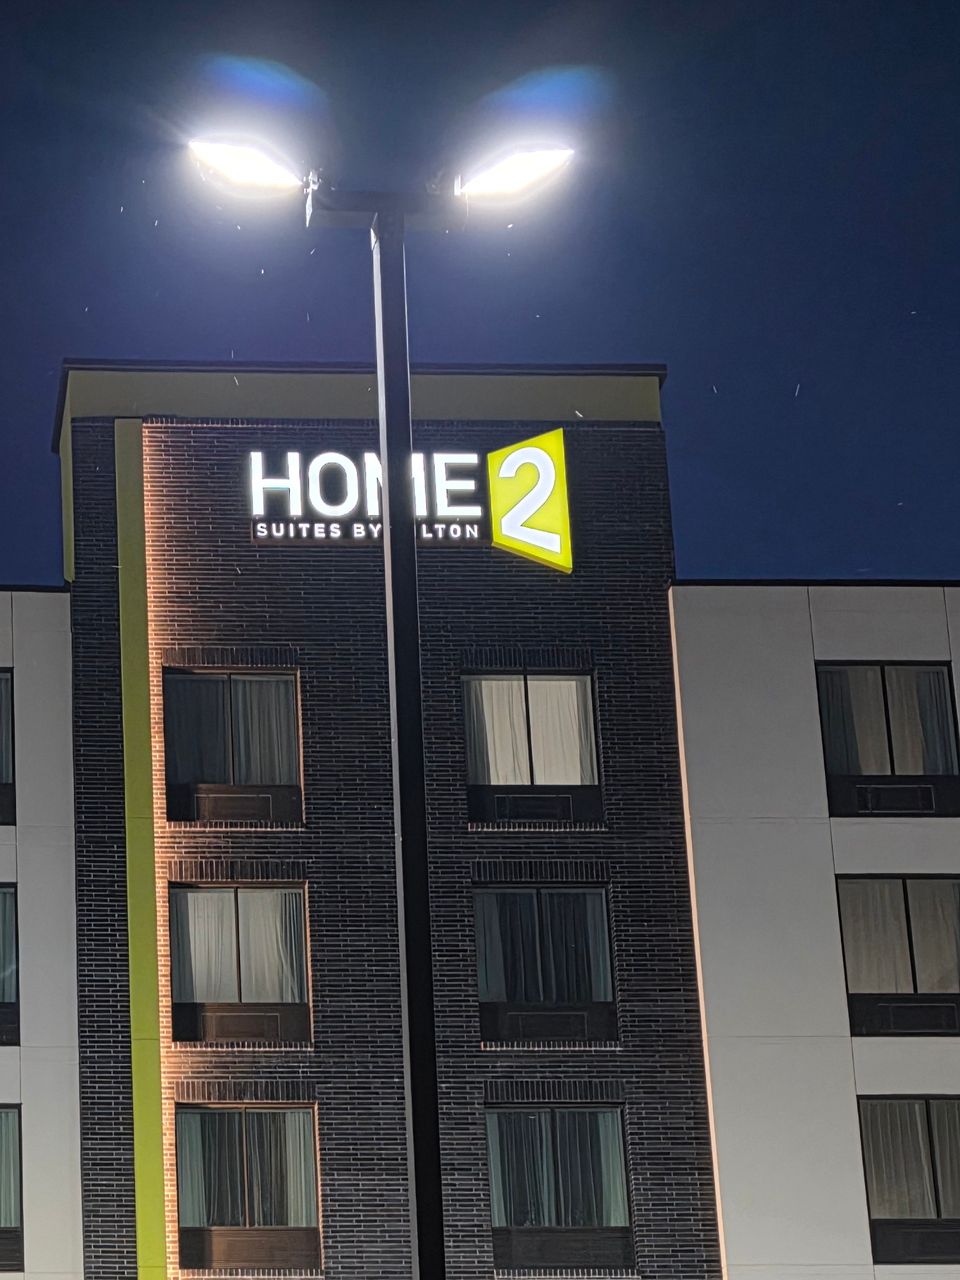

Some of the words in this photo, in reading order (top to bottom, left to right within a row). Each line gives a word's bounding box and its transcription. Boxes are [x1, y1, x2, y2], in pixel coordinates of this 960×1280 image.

[256, 522, 342, 539] SUITES
[353, 522, 382, 539] BY
[421, 523, 479, 539] LTON
[498, 446, 562, 555] 2
